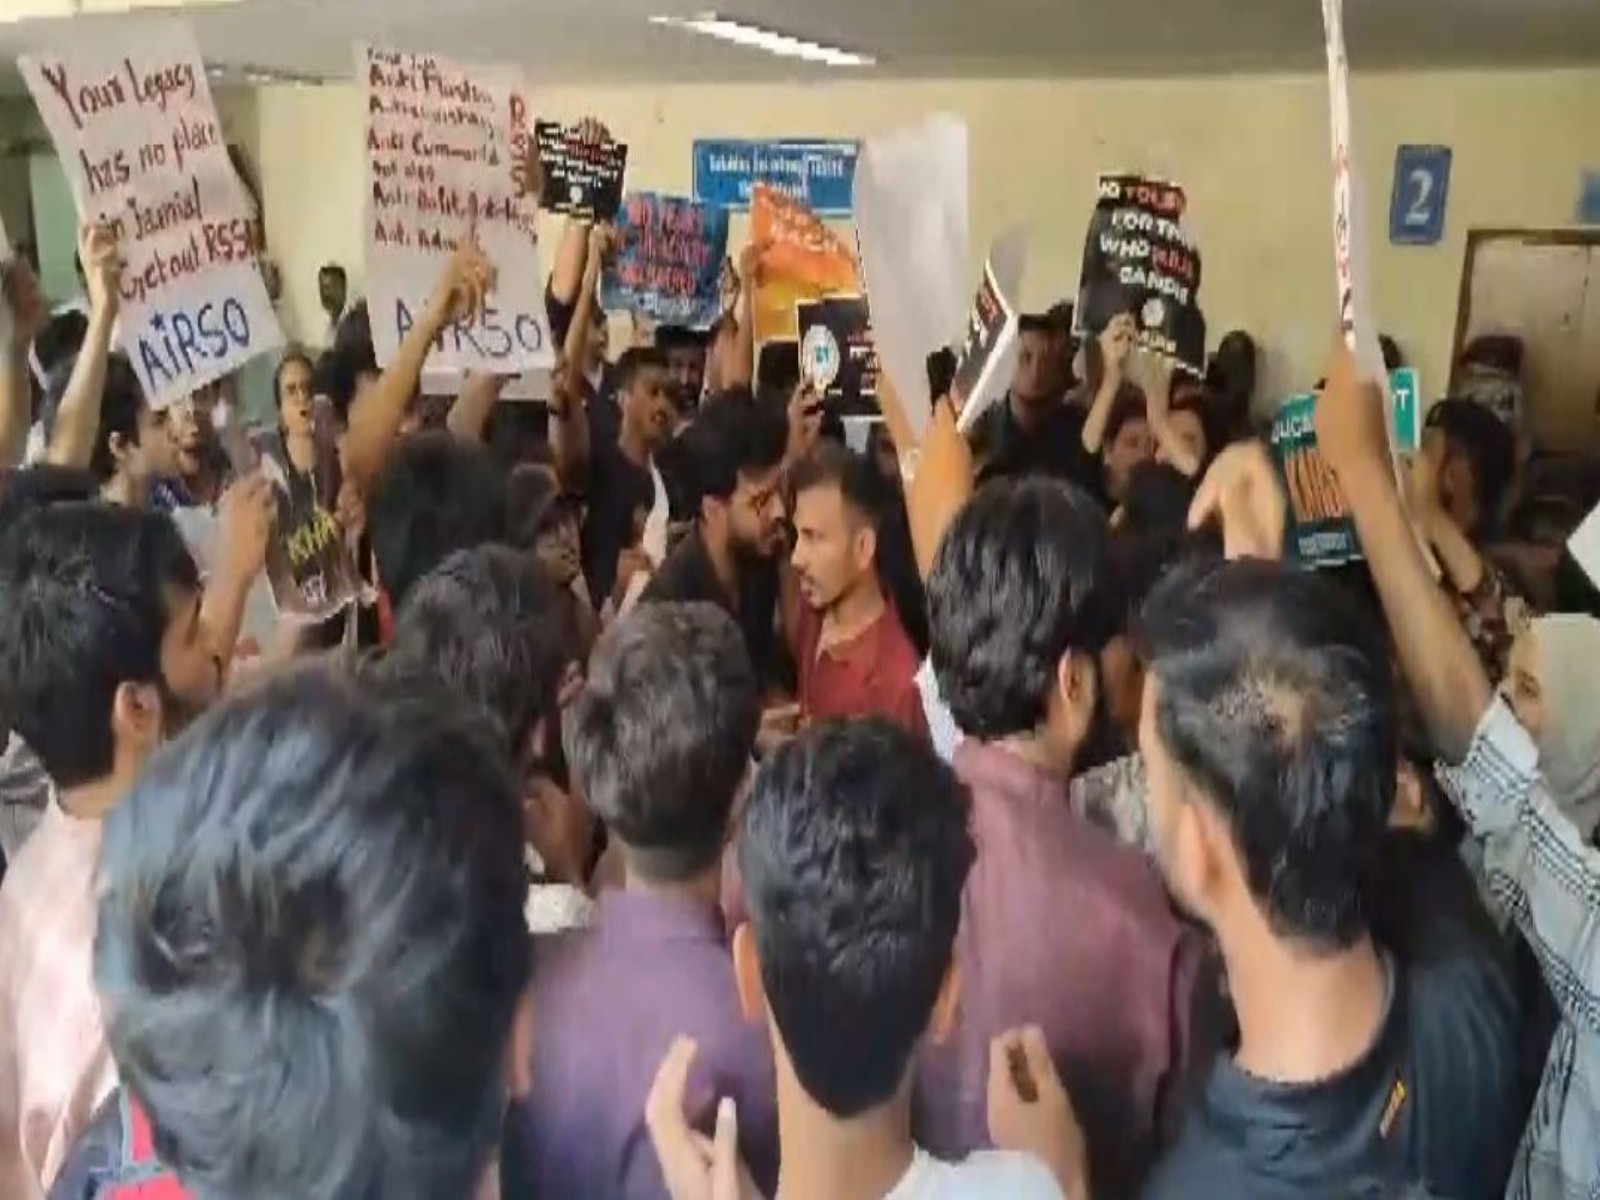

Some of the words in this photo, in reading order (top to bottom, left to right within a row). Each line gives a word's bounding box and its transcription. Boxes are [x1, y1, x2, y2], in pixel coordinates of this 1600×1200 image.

[41, 63, 124, 130] Your
[79, 148, 131, 197] has
[138, 144, 167, 173] no
[1405, 168, 1433, 226] 2
[1099, 233, 1151, 257] WHO
